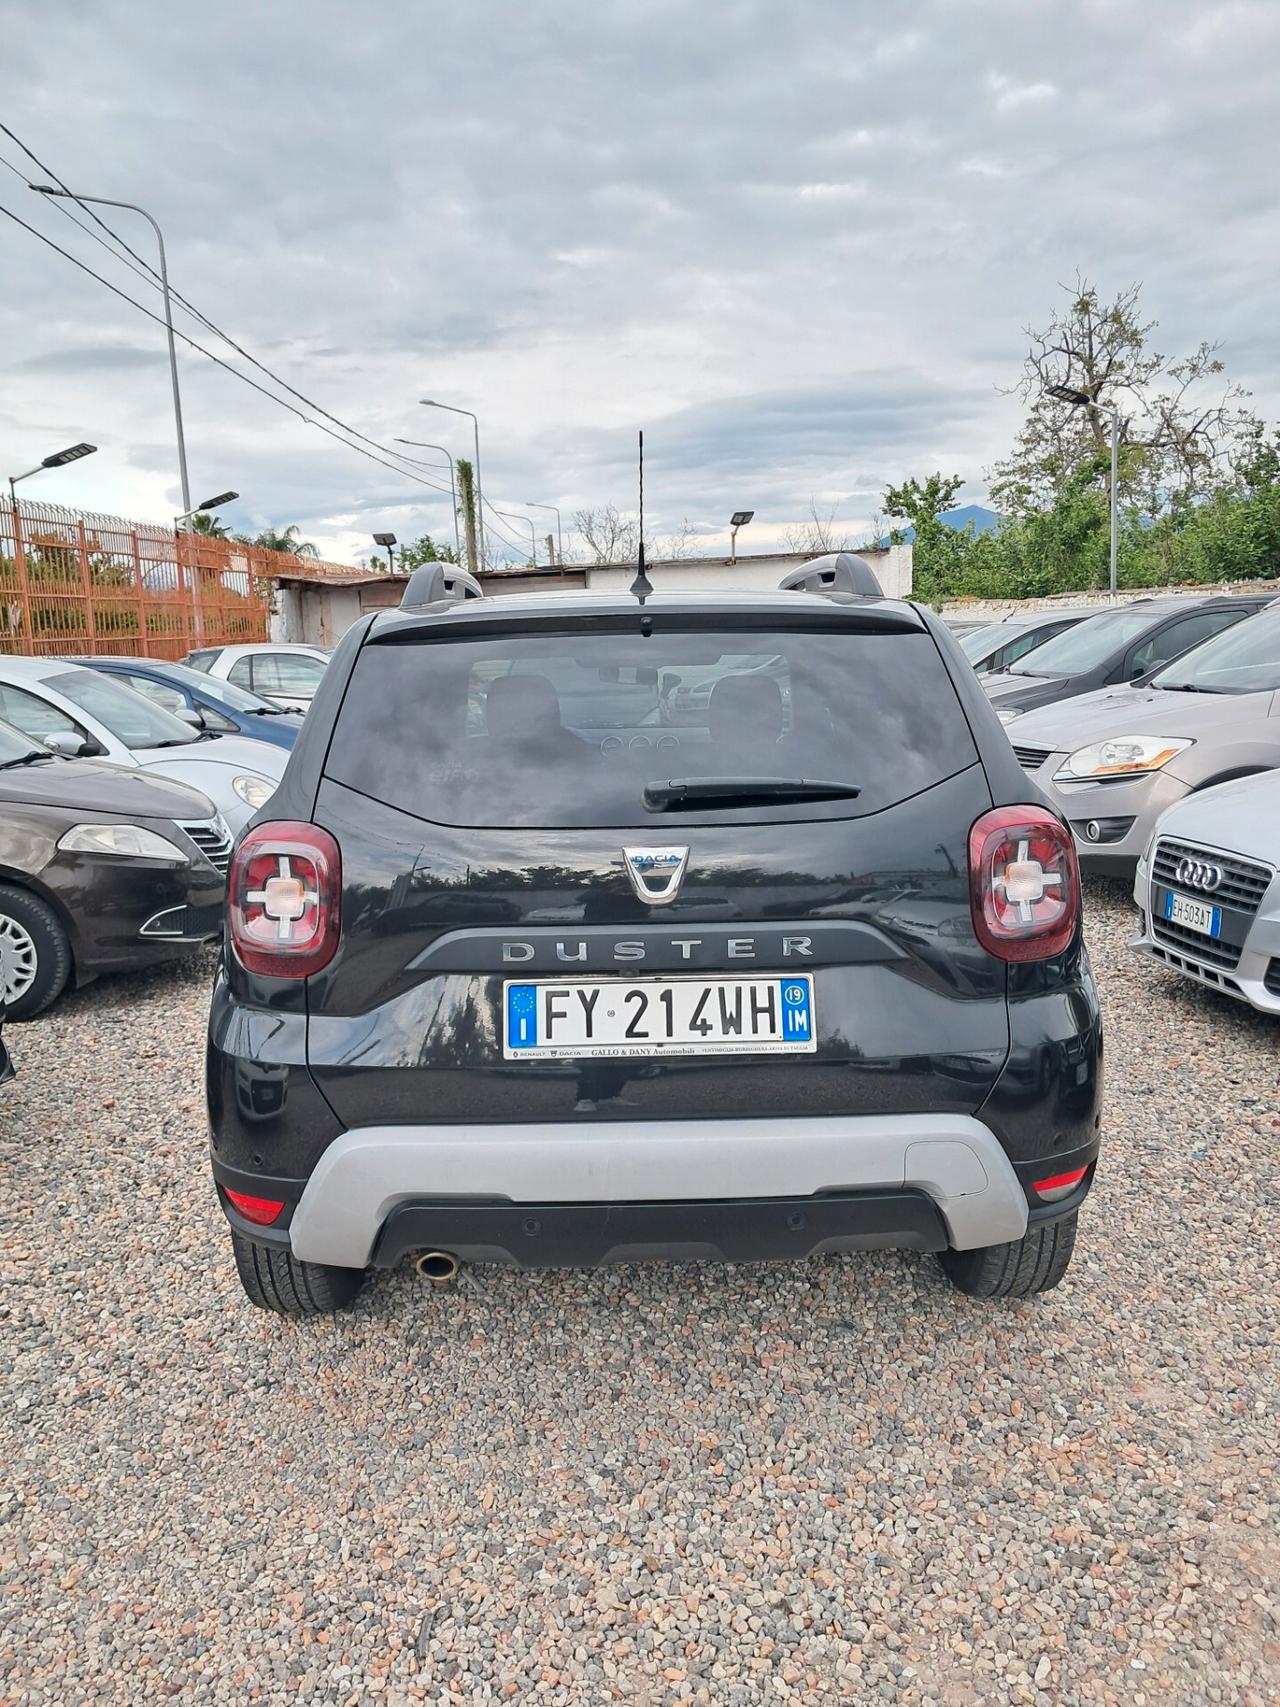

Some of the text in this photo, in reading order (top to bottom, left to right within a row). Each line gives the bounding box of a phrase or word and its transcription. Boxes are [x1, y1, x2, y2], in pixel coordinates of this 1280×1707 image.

[634, 854, 680, 863] DACIA
[502, 936, 814, 962] DUSTER
[789, 989, 801, 1001] 19
[545, 985, 776, 1039] FY 214WH
[788, 1009, 807, 1032] IM
[653, 1047, 695, 1055] Automobili
